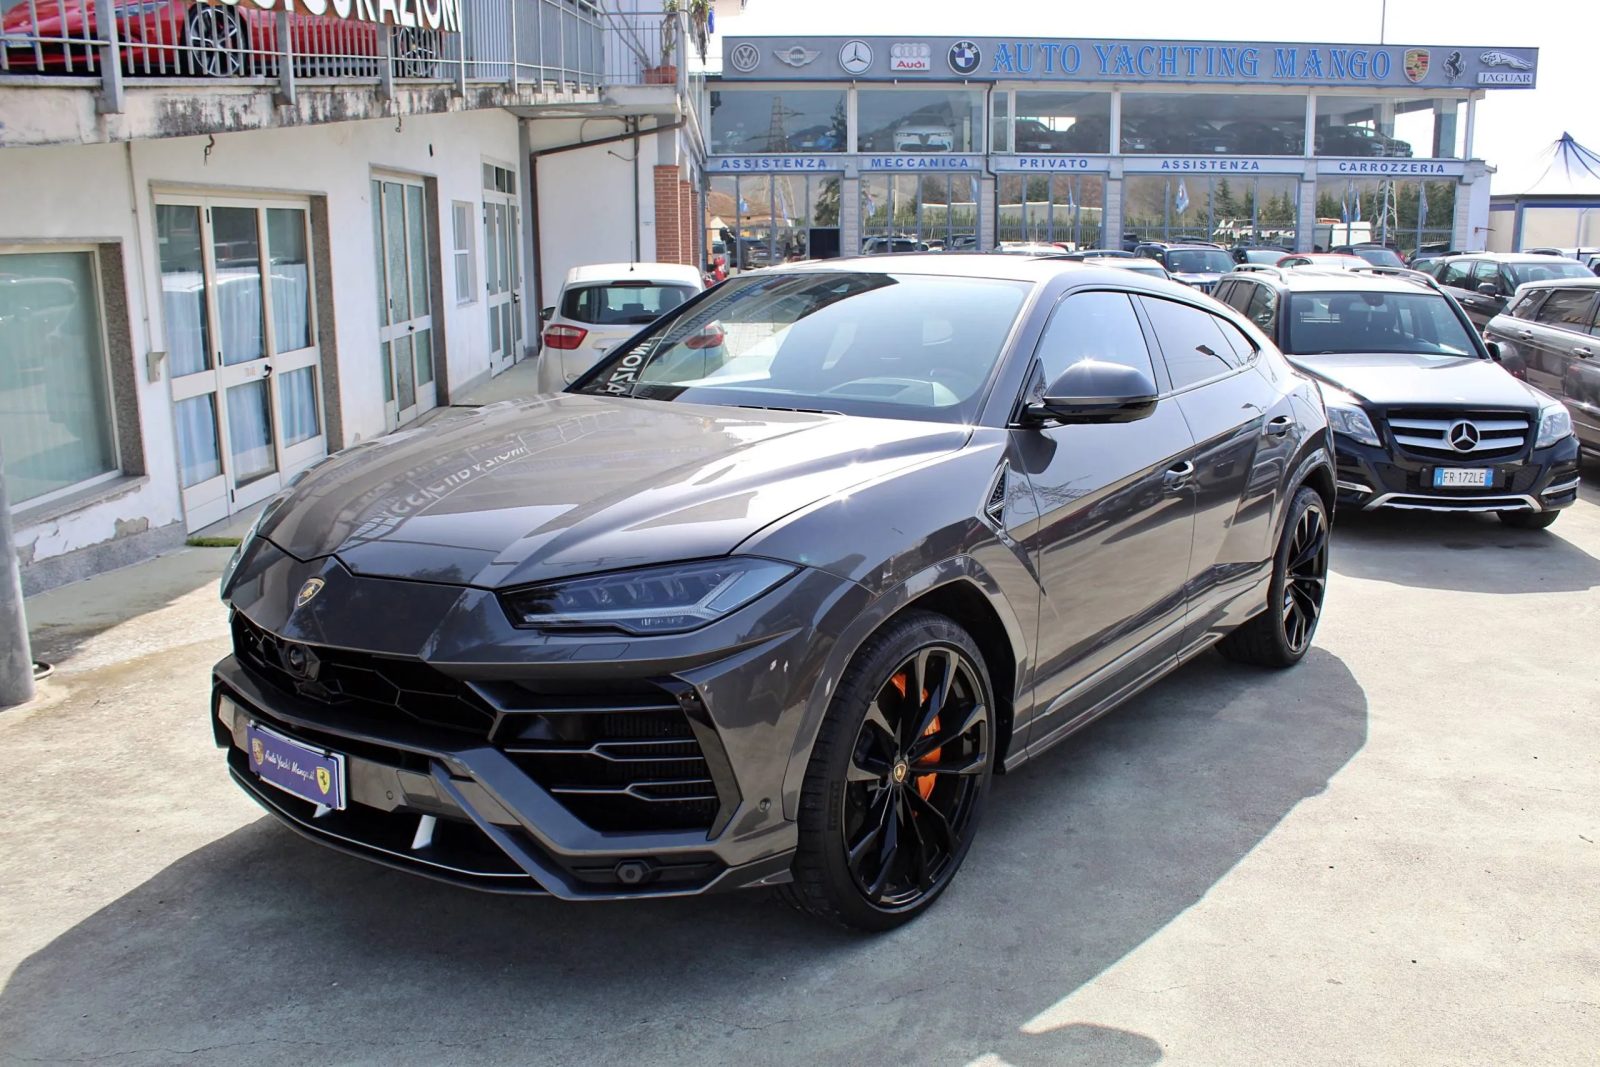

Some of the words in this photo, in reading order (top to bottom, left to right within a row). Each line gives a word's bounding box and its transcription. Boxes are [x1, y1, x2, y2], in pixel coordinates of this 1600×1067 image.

[897, 60, 925, 68] Audi
[991, 43, 1082, 73] AUTO
[1093, 44, 1259, 77] YACHTING
[1272, 48, 1391, 80] MANGO
[1481, 73, 1531, 84] JAGUAR
[721, 159, 827, 169] ASSISTENZA
[871, 158, 969, 168] MECCANICA
[1019, 158, 1088, 168] PRIVATO
[1161, 160, 1260, 171] ASSISTENZA
[1338, 162, 1445, 174] CARROZZERIA
[1443, 472, 1454, 482] FR
[1458, 472, 1484, 483] 172LE
